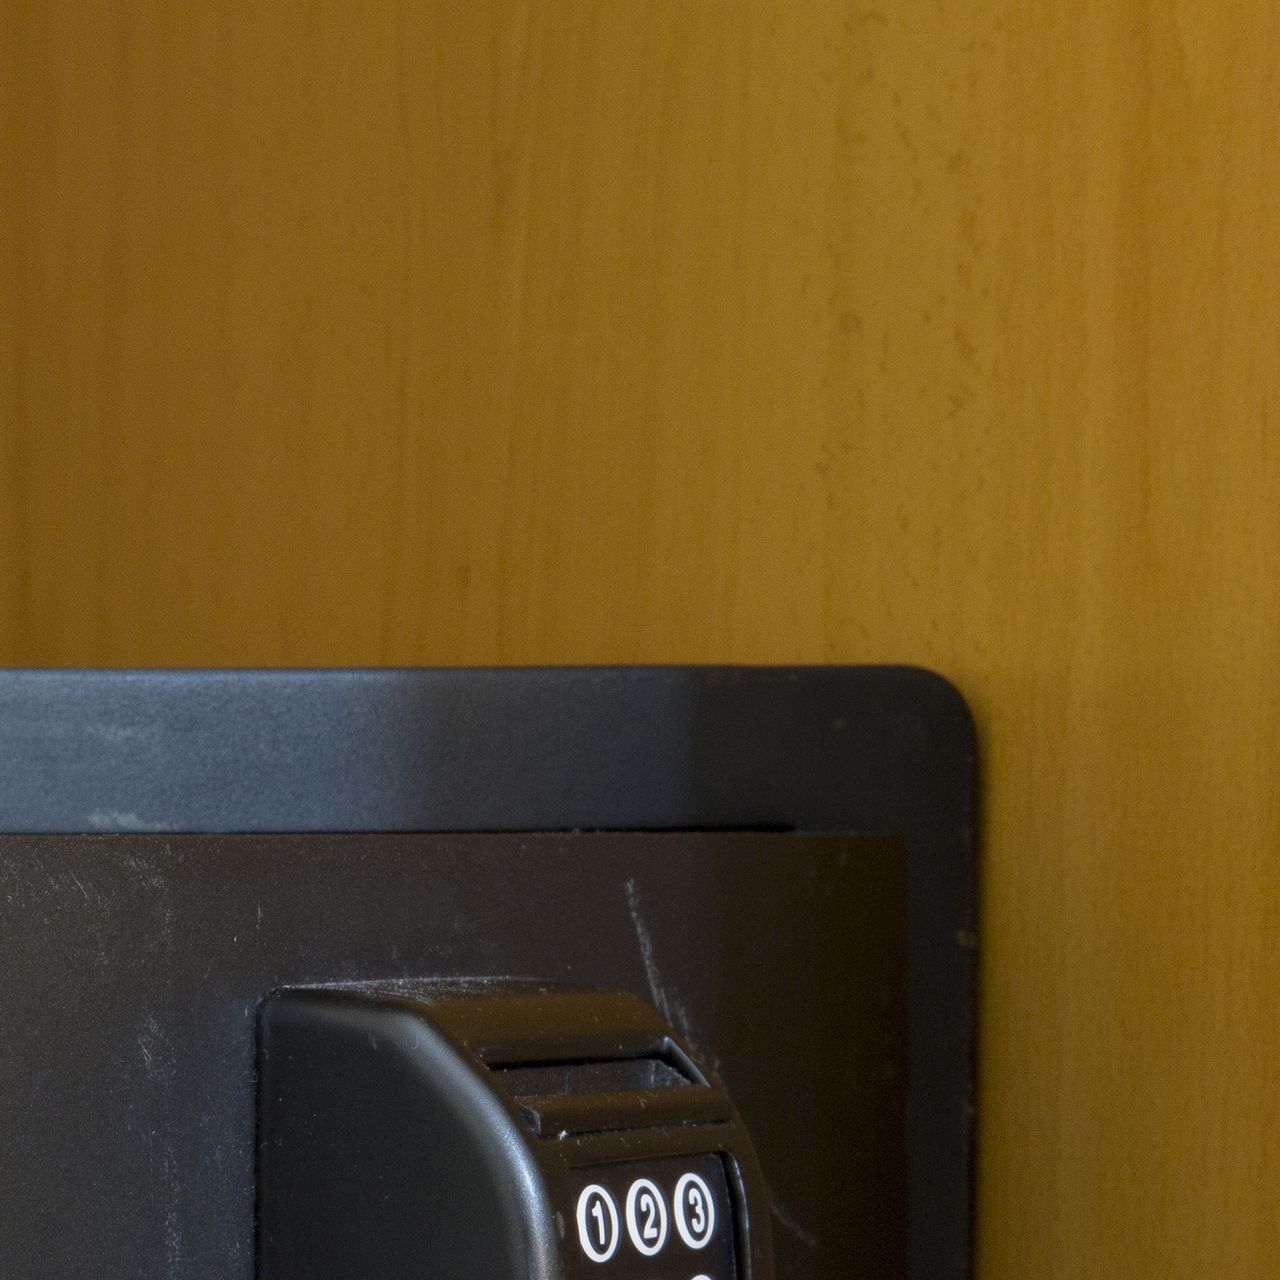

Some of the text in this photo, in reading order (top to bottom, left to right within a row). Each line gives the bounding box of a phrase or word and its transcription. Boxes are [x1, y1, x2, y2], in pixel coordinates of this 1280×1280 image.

[590, 1186, 707, 1247] 1 2 3
